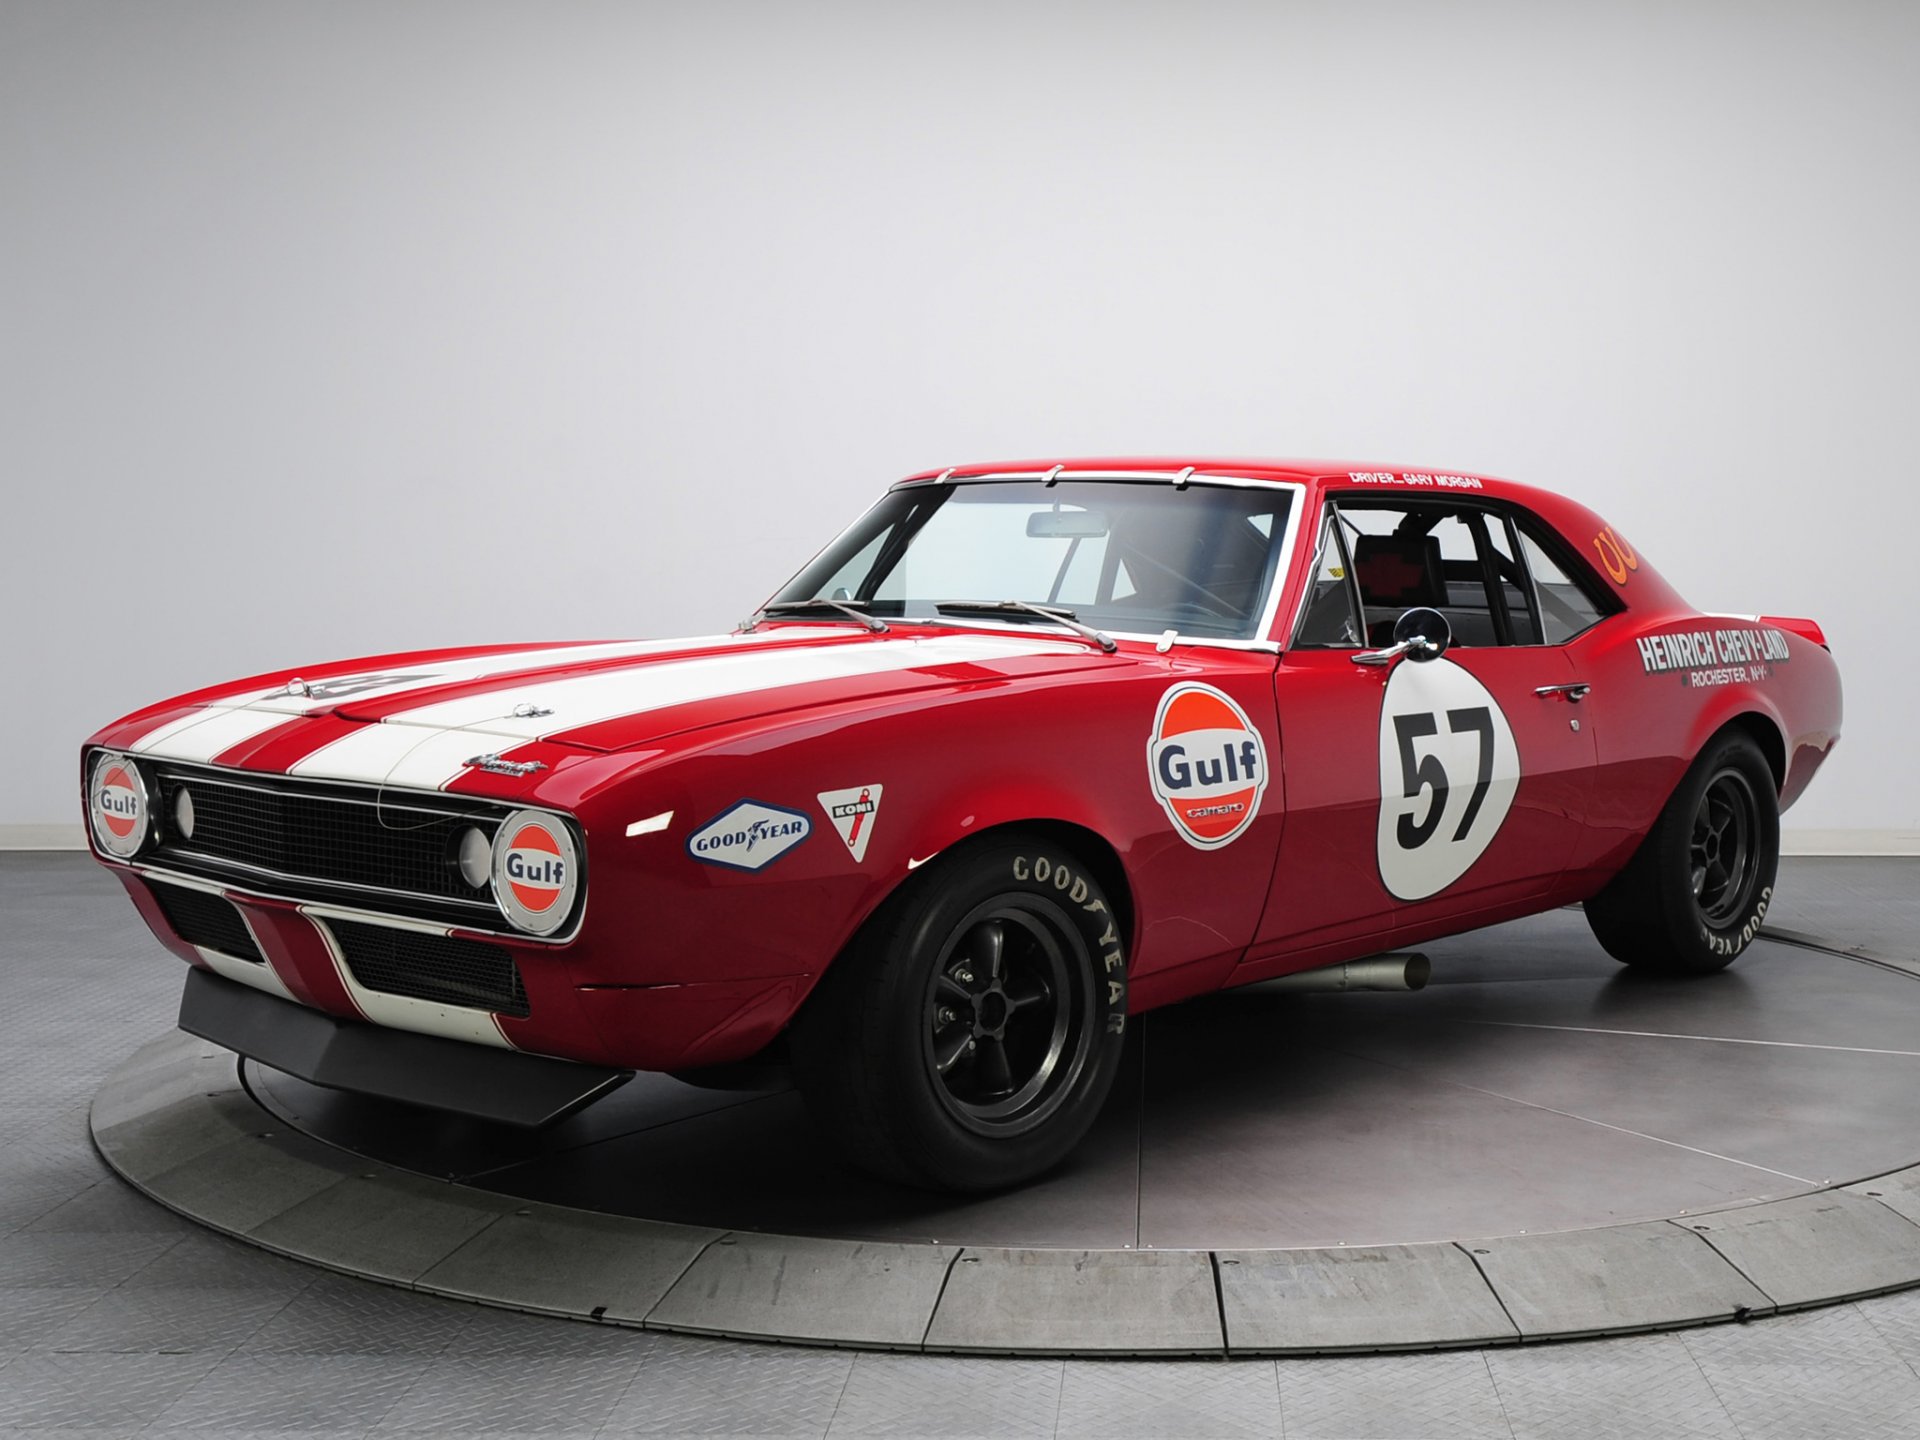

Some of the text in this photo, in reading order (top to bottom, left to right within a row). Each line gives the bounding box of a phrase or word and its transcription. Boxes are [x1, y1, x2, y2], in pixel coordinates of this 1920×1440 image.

[1403, 473, 1433, 486] GARY
[1434, 475, 1483, 489] MORGAN
[1636, 629, 1790, 673] HEINRICH CHEVY-LAND
[1158, 740, 1257, 790] Gulf
[1393, 707, 1495, 850] 57
[100, 789, 137, 815] Gulf
[834, 801, 873, 818] KONI
[506, 853, 565, 884] Gulf
